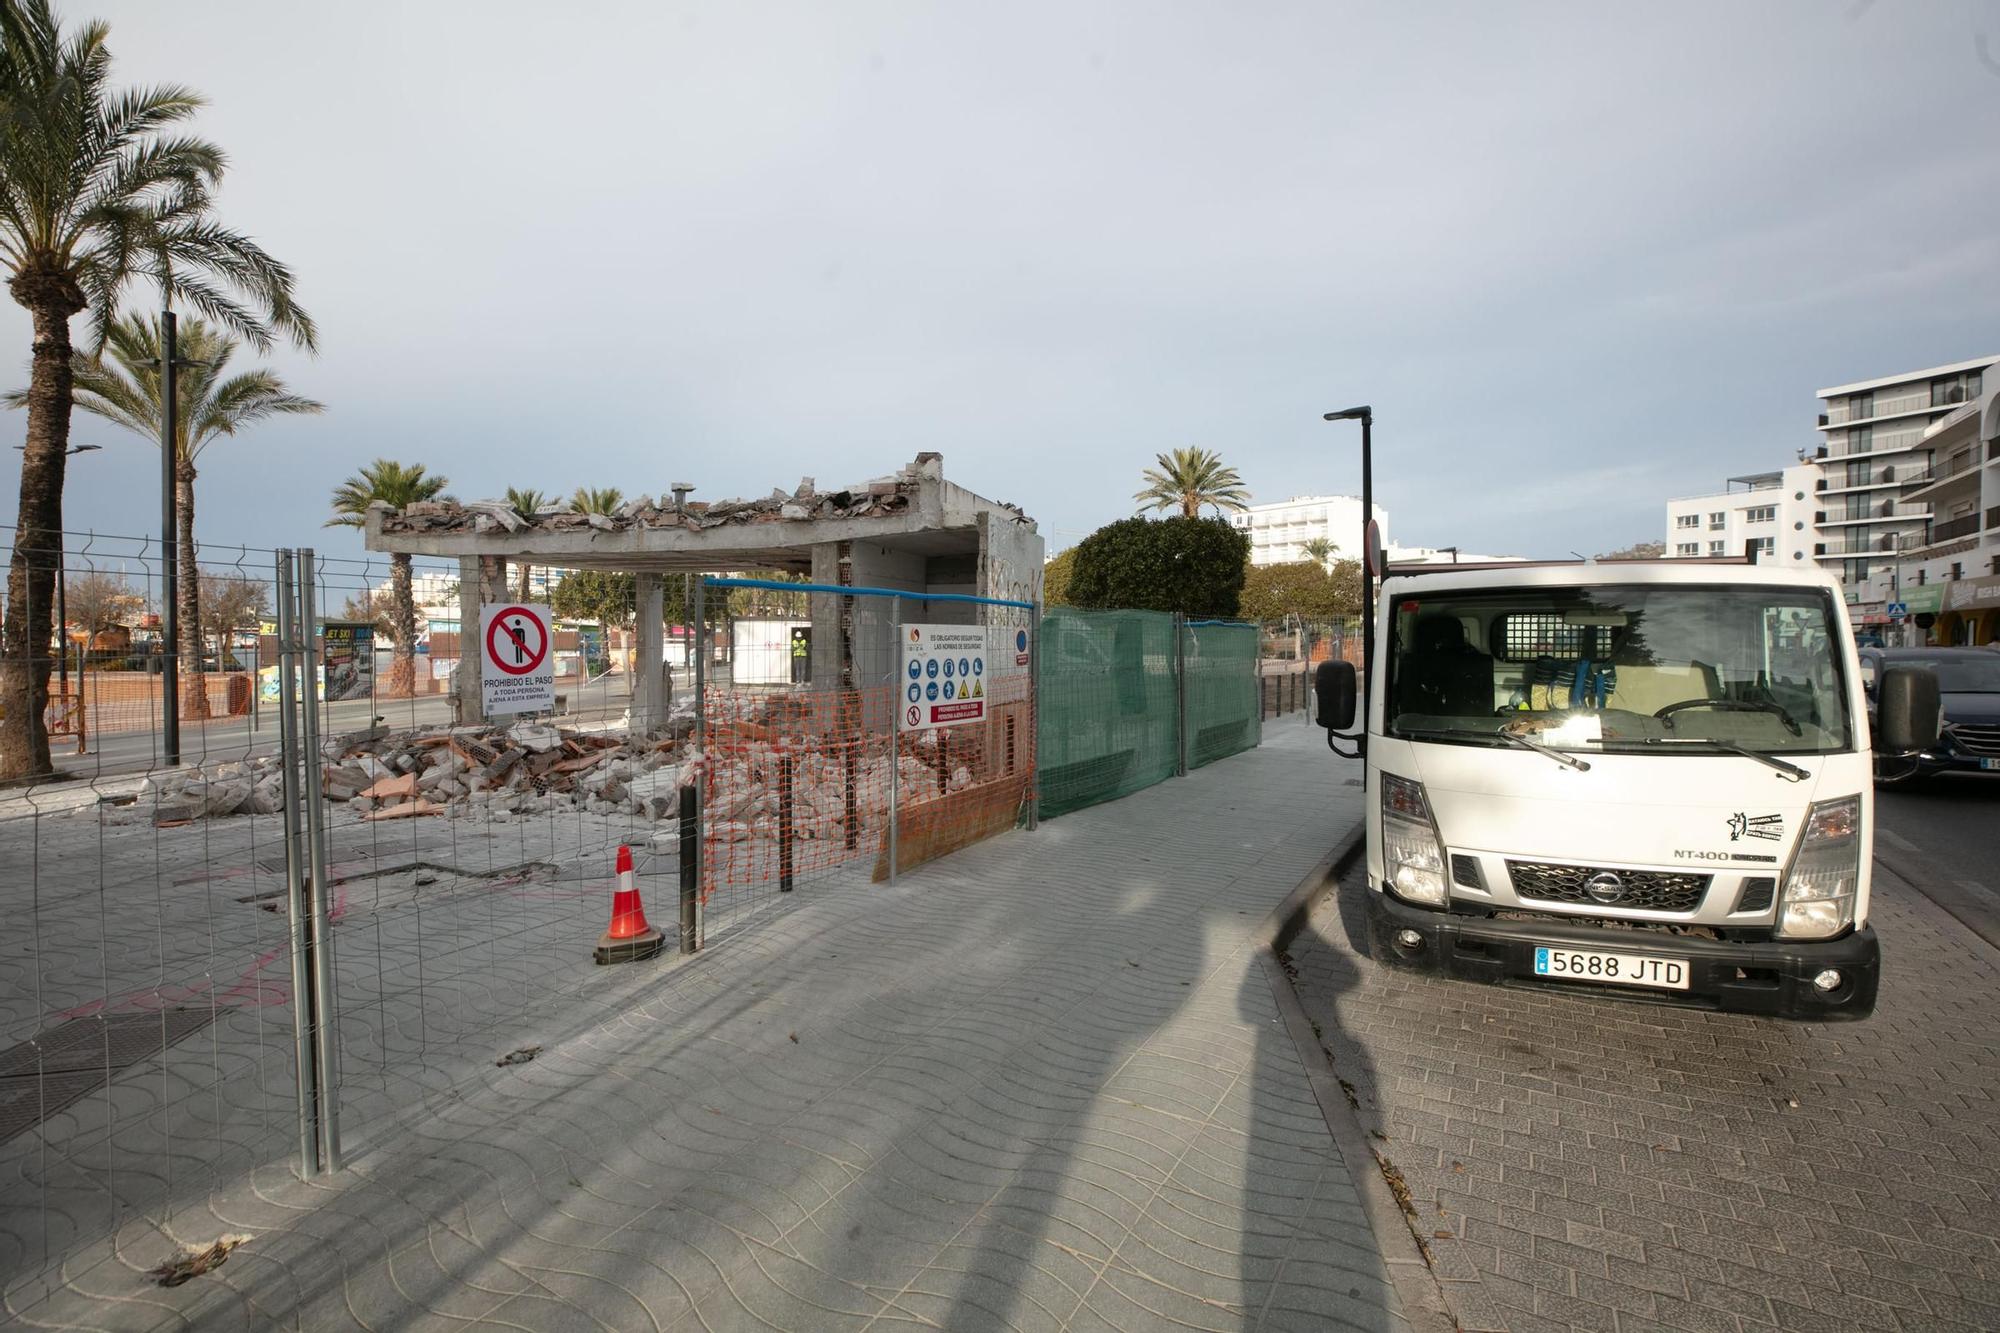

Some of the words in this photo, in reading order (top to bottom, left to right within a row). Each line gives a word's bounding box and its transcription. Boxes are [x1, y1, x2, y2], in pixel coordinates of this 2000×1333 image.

[325, 629, 338, 639] JET
[339, 629, 351, 639] SKI
[485, 678, 523, 688] PROHIBIDO
[525, 677, 533, 685] EL
[535, 676, 552, 685] PASO
[517, 687, 545, 695] PERSONA
[1674, 850, 1729, 861] NT400
[1591, 883, 1623, 893] NISSAN
[1553, 952, 1619, 977] 5688
[1631, 960, 1682, 984] JTD
